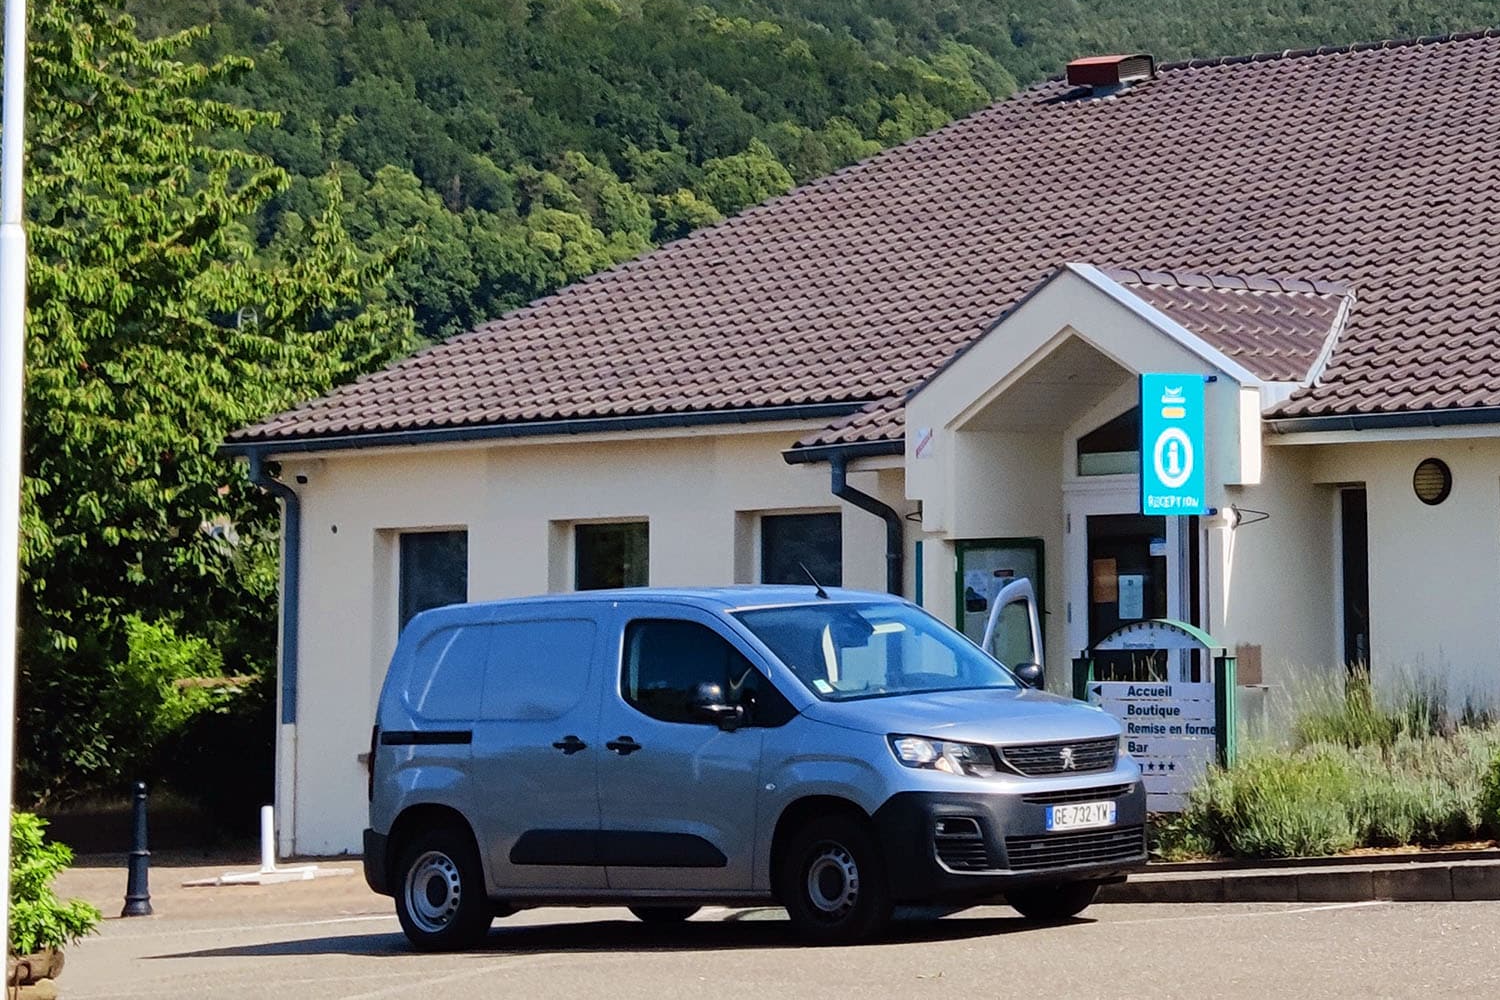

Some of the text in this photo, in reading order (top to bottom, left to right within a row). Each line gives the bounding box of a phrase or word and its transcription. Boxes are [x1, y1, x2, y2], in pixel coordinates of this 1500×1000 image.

[1127, 685, 1172, 697] Accueil
[1127, 703, 1181, 718] Boutique
[1127, 722, 1216, 735] Remise en forme
[1128, 741, 1149, 753] Bar
